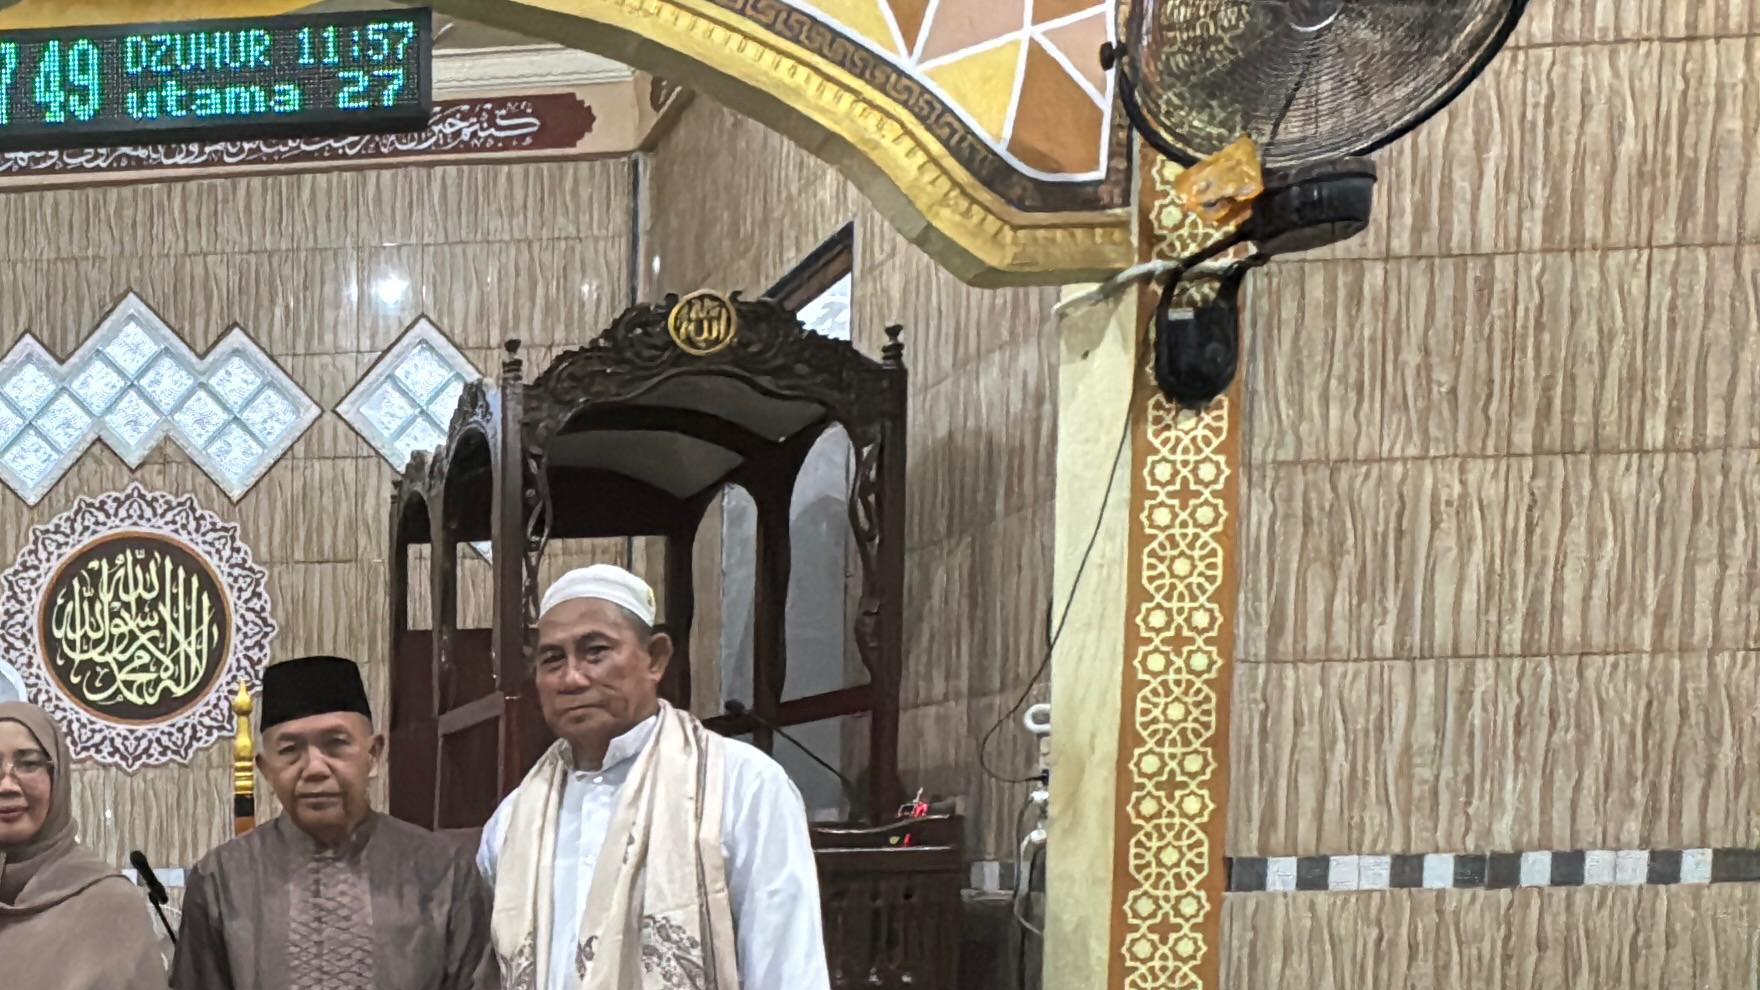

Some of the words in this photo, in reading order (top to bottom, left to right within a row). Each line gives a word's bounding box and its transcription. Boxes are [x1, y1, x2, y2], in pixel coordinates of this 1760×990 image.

[123, 28, 272, 75] DZUHUR
[297, 20, 415, 66] 11:57
[34, 38, 101, 124] 49
[125, 79, 304, 121] utama
[338, 68, 406, 111] 27
